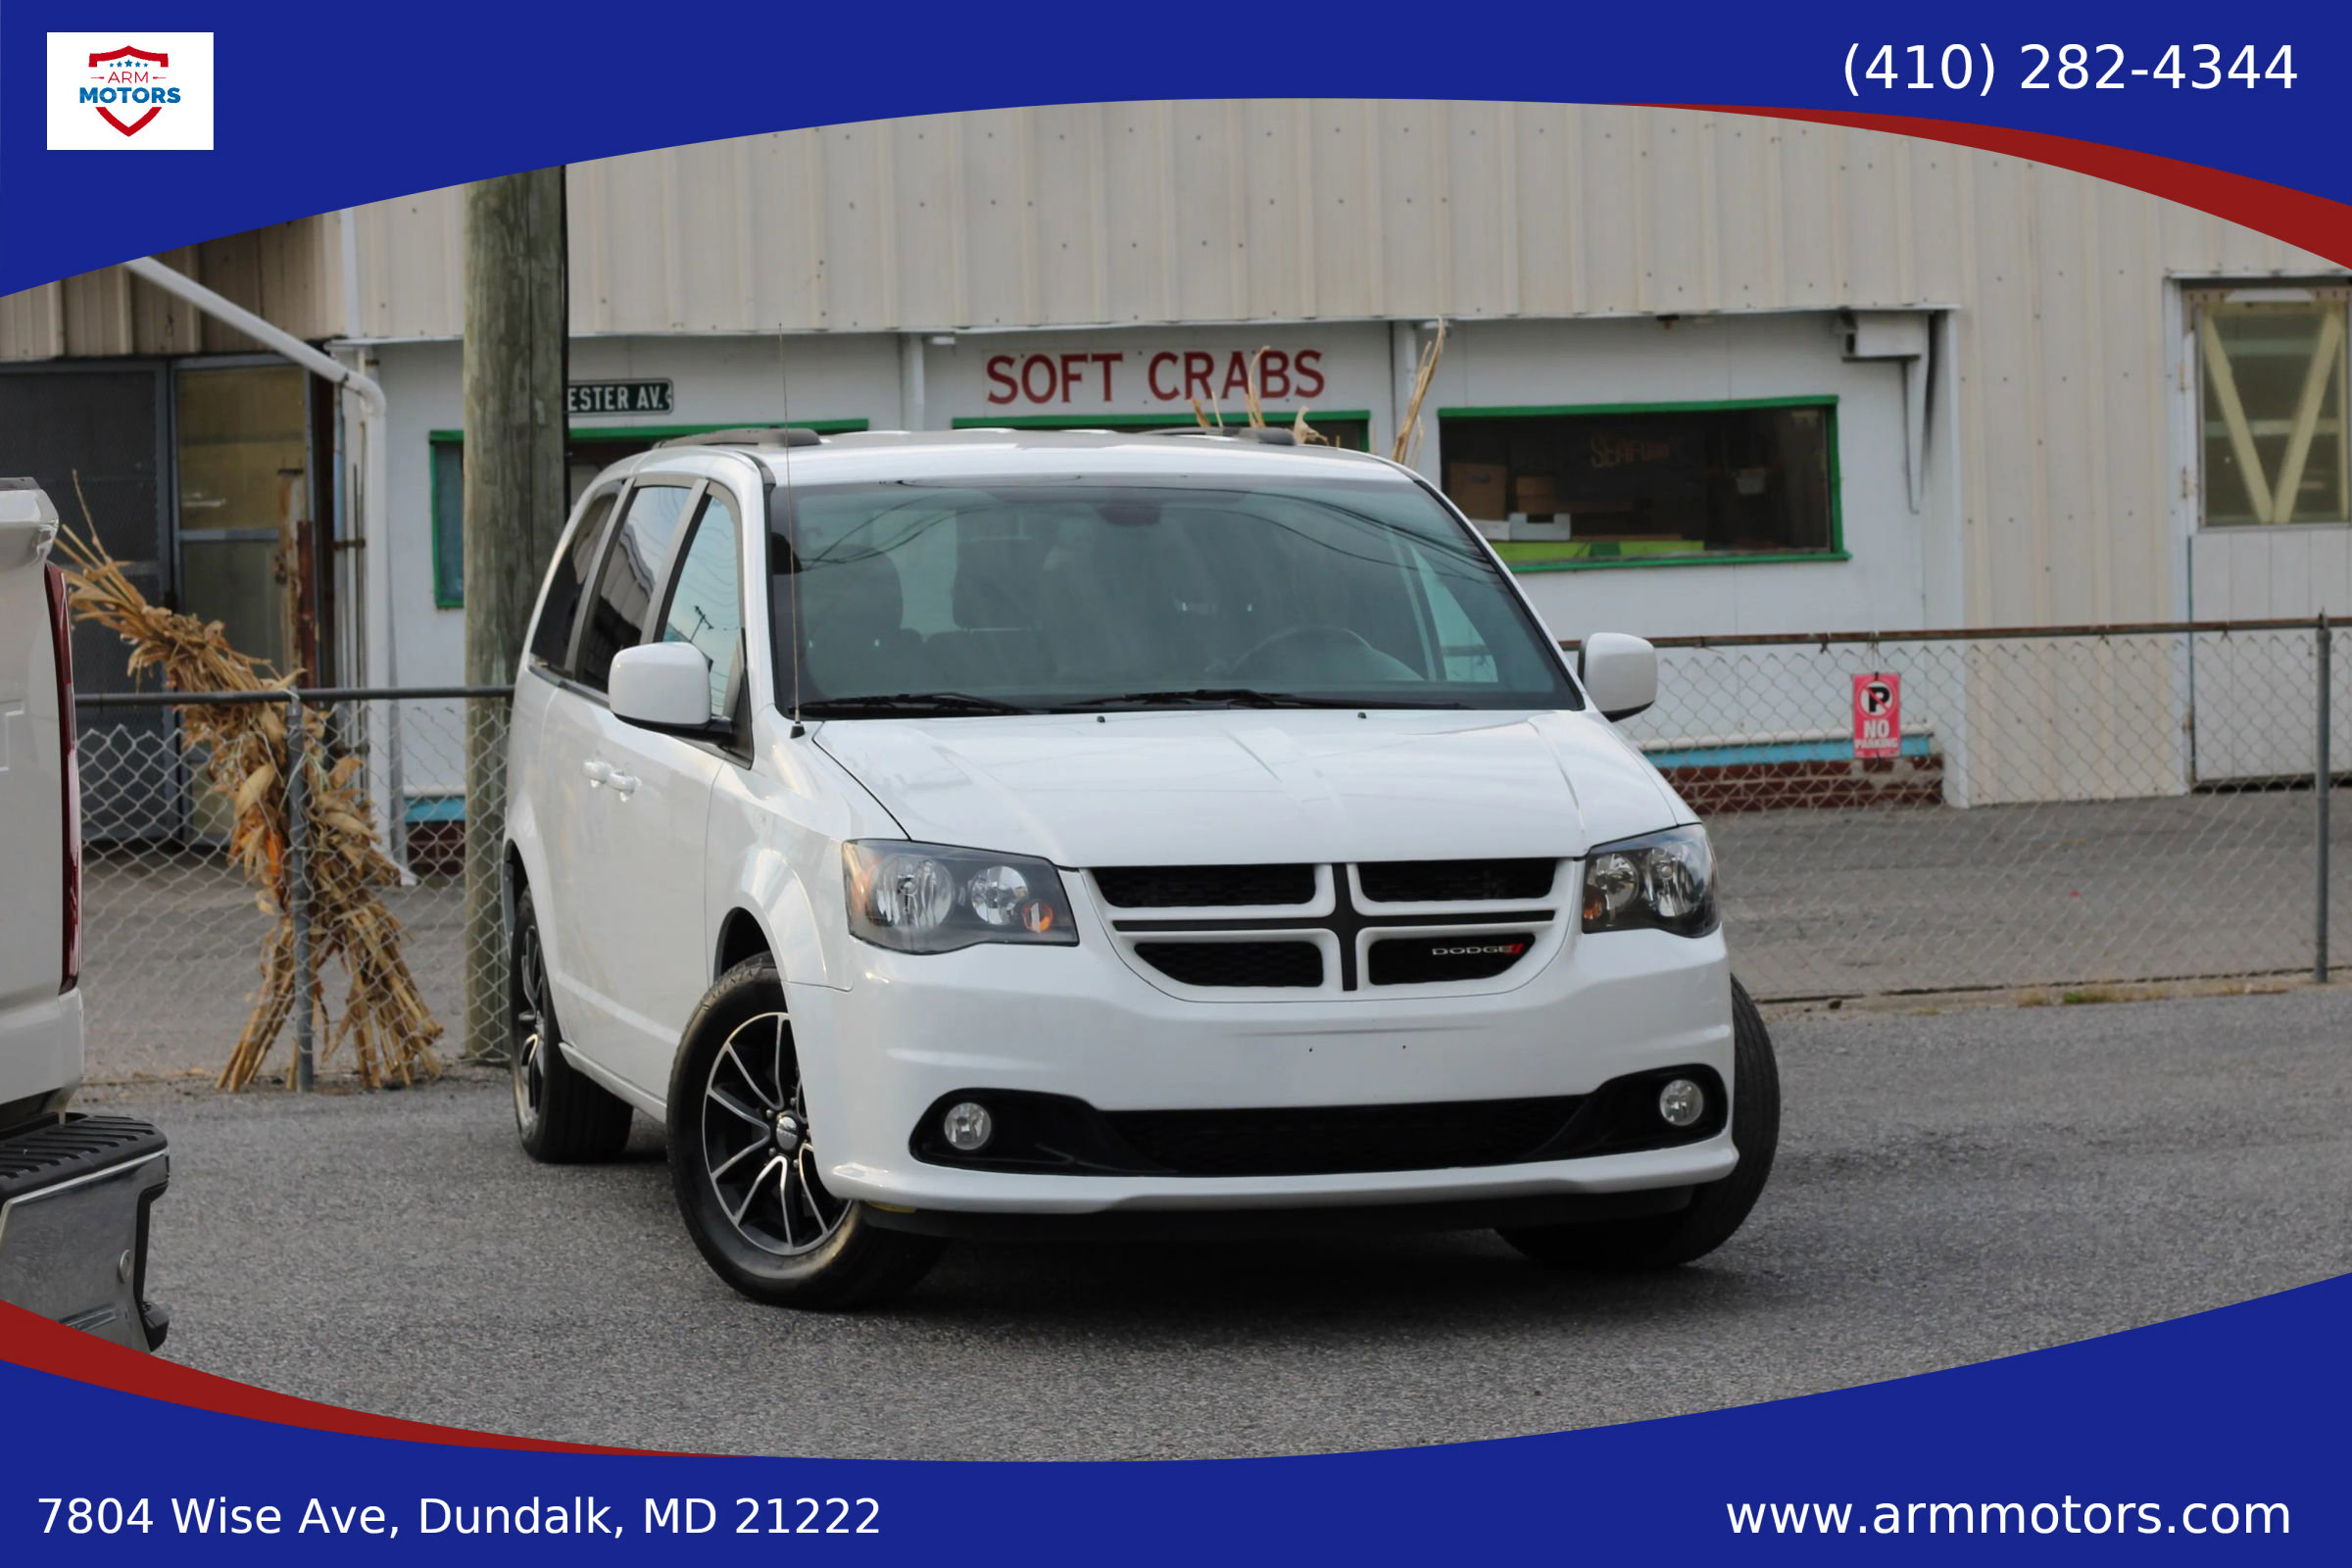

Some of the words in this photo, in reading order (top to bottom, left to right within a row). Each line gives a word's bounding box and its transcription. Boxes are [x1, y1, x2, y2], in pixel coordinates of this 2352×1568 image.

[986, 353, 1124, 405] SOFT
[1148, 349, 1325, 400] CRABS
[568, 387, 629, 411] ESTER
[637, 386, 663, 409] AV.
[1864, 719, 1889, 738] NO
[1432, 945, 1514, 956] DODGE
